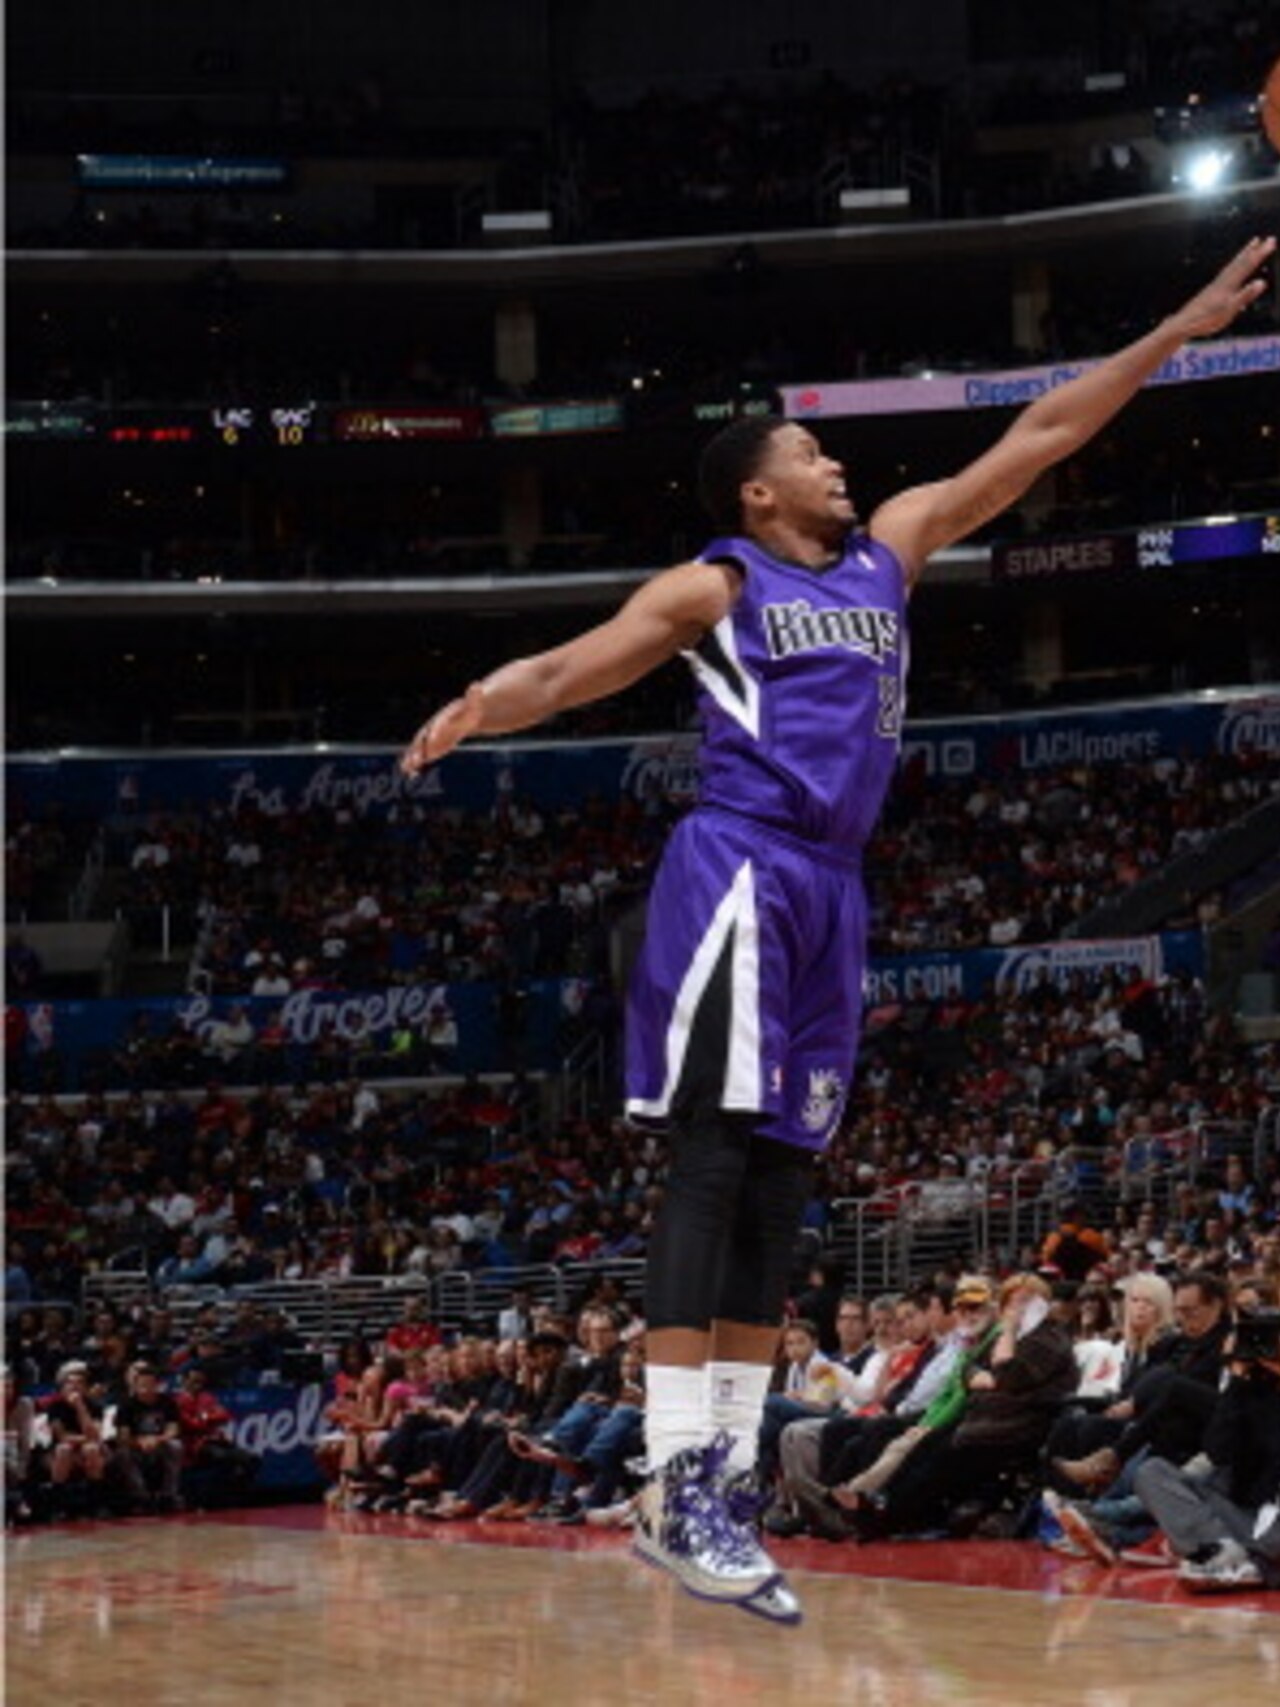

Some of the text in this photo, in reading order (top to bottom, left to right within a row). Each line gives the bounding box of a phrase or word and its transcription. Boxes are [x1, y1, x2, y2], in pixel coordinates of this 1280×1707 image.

[213, 407, 252, 429] LAC
[277, 426, 304, 446] 10
[1006, 537, 1113, 577] STAPLES
[762, 599, 898, 666] Kings
